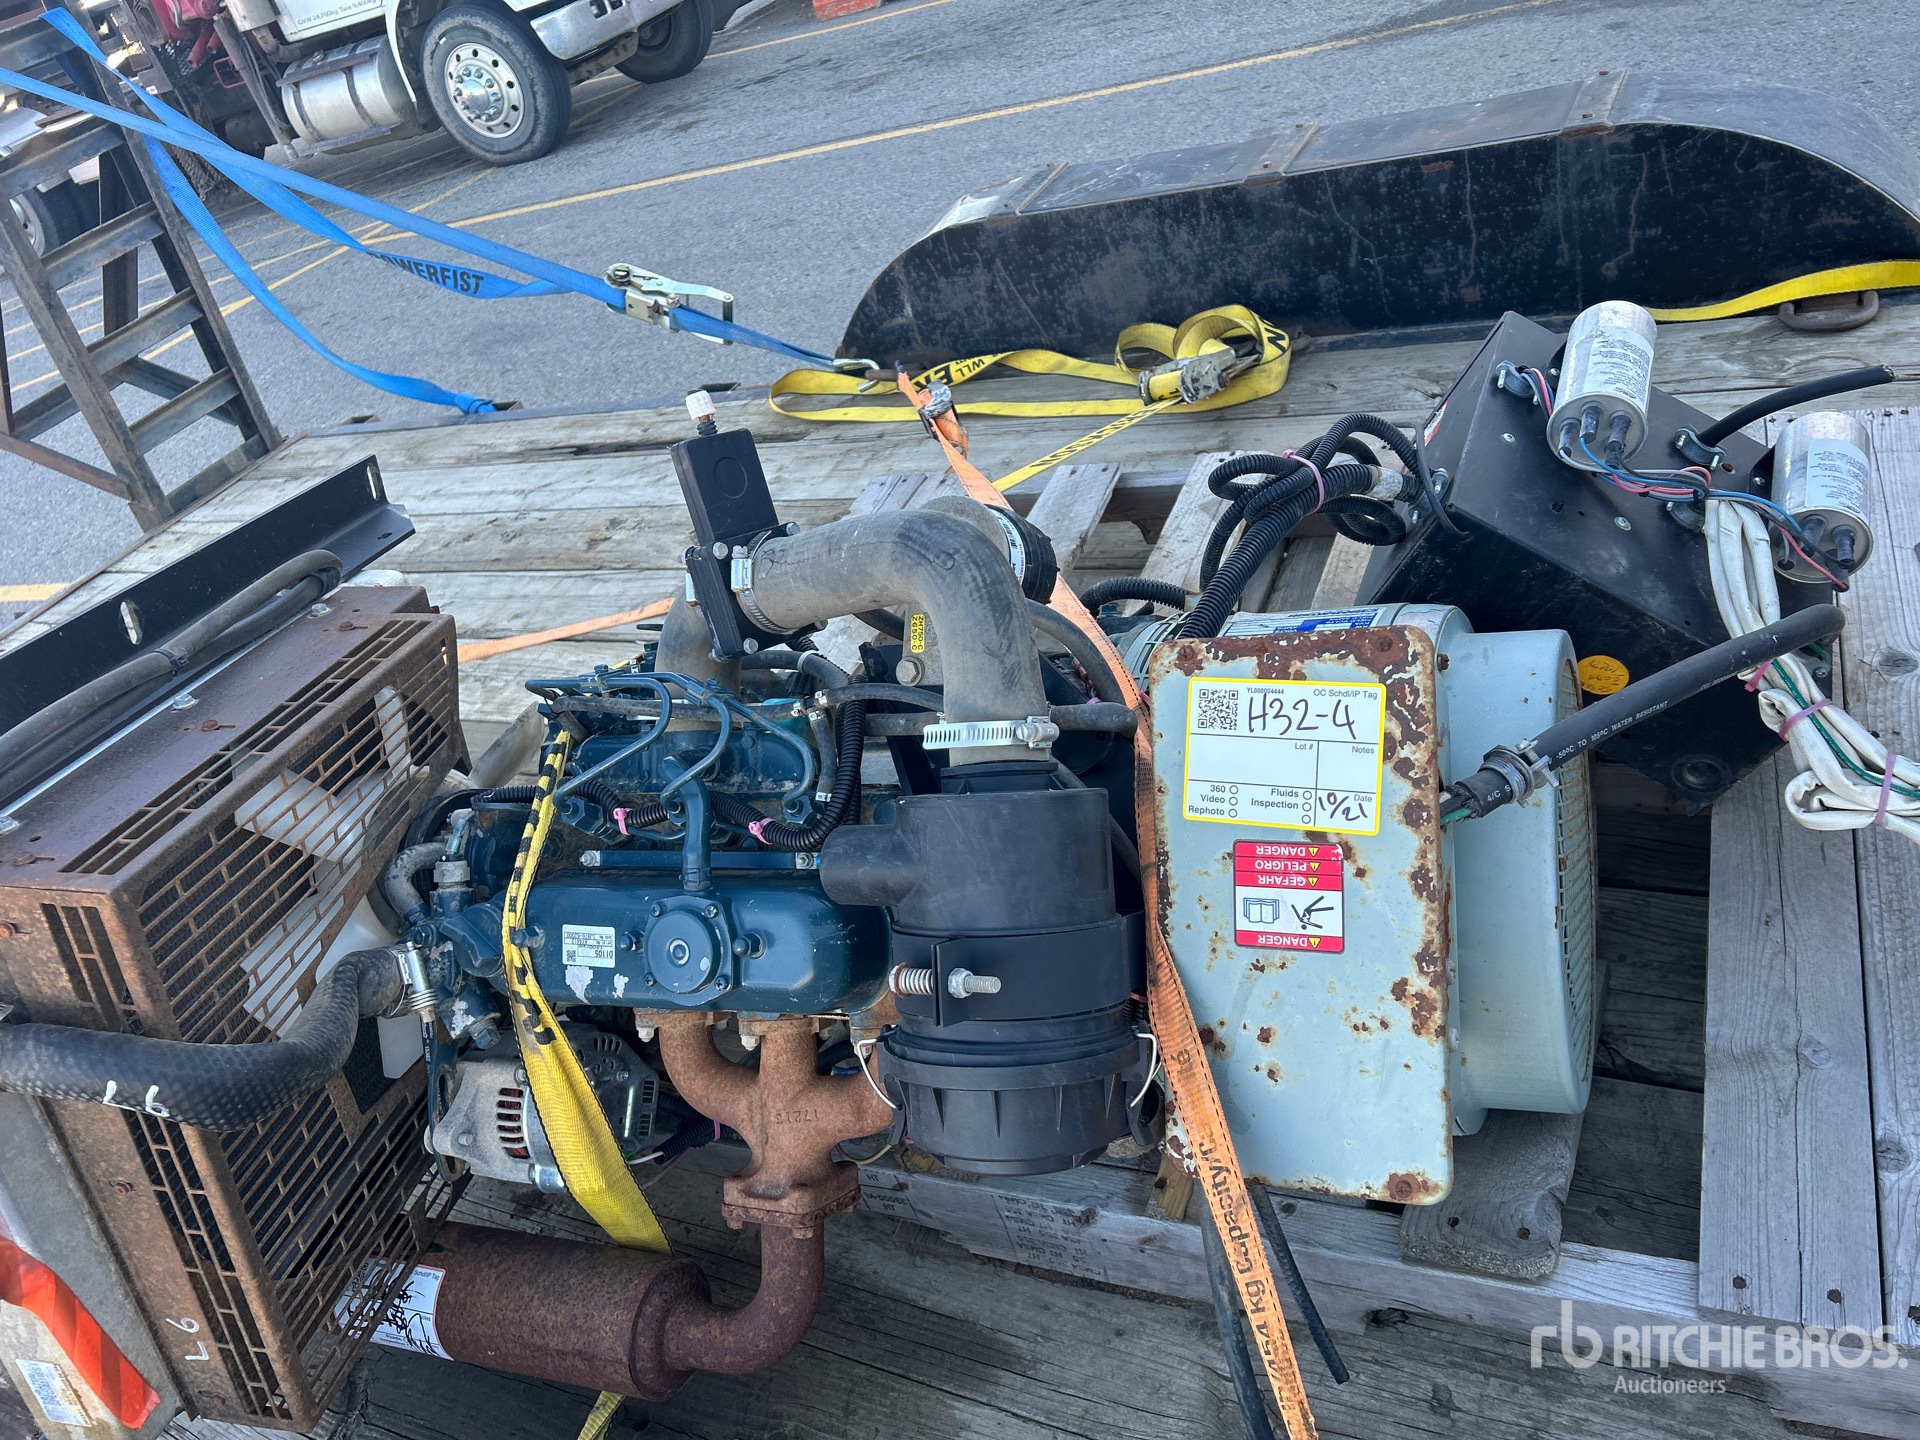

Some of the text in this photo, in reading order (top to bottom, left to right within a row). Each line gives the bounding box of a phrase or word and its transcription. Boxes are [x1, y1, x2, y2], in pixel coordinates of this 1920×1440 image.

[1313, 688, 1327, 697] OC
[1362, 690, 1378, 700] Tag
[1577, 738, 1587, 748] TO
[1611, 716, 1633, 731] WATER
[1635, 700, 1669, 719] RESISTANT
[1294, 742, 1314, 751] Lot #
[1352, 745, 1375, 755] Notes
[1210, 785, 1226, 794] 360
[1270, 788, 1299, 798] Fluids
[1200, 794, 1226, 804] Video
[1251, 798, 1299, 810] Inspection
[1354, 794, 1373, 803] Date
[1188, 805, 1225, 816] Rephoto
[1255, 845, 1306, 857] DANGER
[1255, 860, 1307, 871] PELIGRO
[1257, 875, 1306, 886] GEFAHR
[1257, 934, 1308, 947] DANGER
